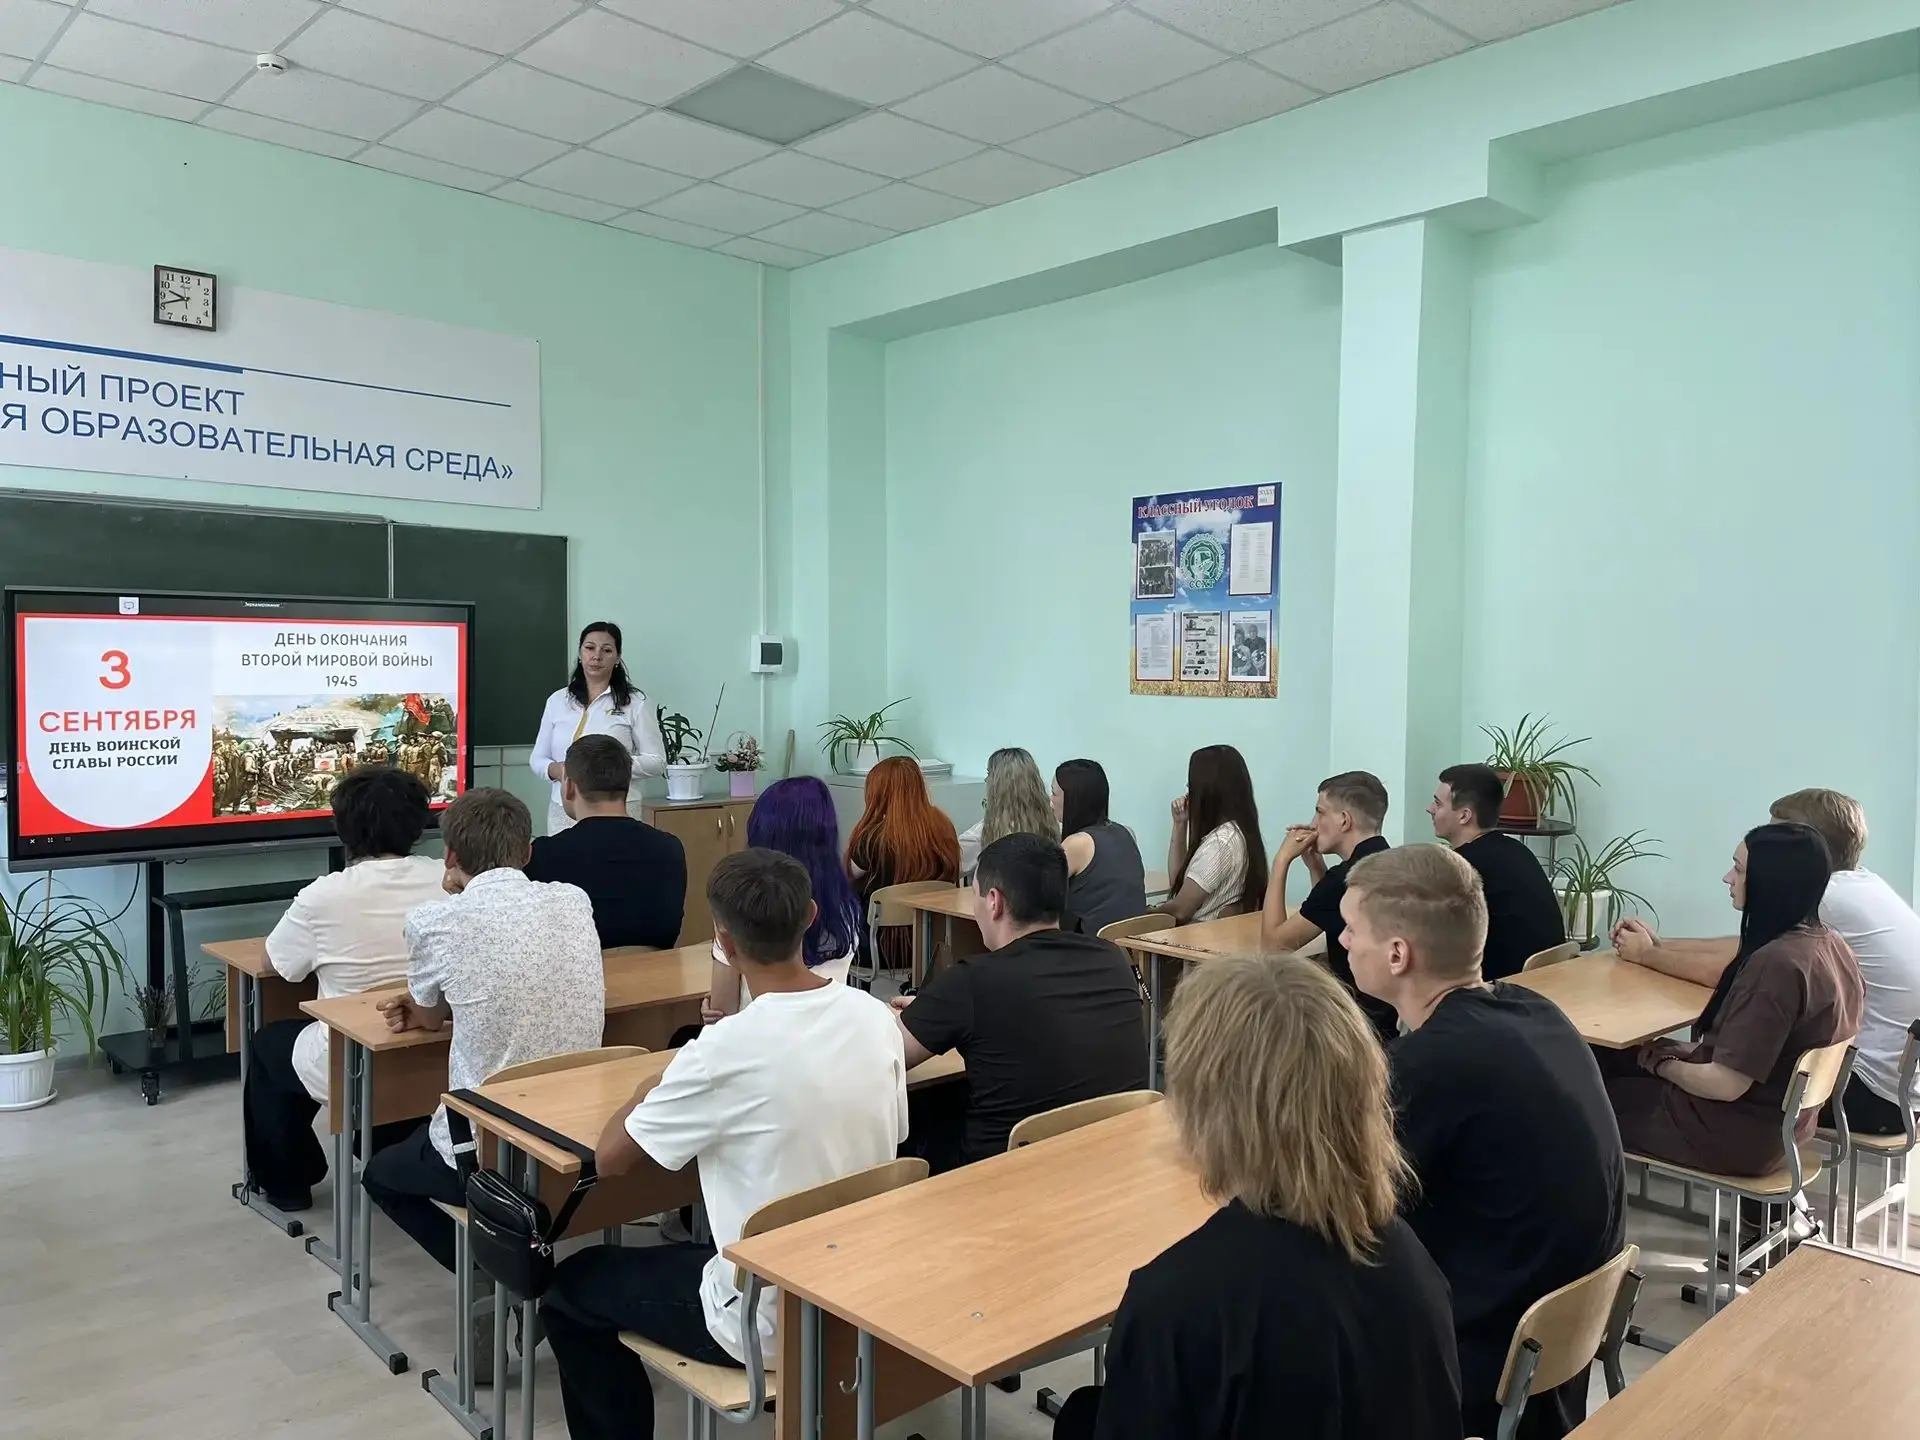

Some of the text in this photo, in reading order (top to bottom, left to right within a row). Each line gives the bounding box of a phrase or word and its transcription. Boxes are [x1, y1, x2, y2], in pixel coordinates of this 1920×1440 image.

[166, 273, 175, 281] 11
[180, 276, 191, 284] 12
[197, 278, 201, 286] 1
[161, 281, 170, 289] 10
[203, 288, 210, 296] 2
[160, 303, 166, 311] 8
[167, 312, 173, 320] 7
[181, 314, 188, 322] 6
[196, 317, 202, 325] 5
[101, 374, 245, 416] ПРОЕКТ
[41, 407, 395, 468] ОБРАЗОВАТЕЛЬНАЯ
[405, 447, 514, 482] СРЕДА»
[1138, 495, 1254, 519] КЛАССНЫЙ УГОЛОК
[275, 633, 408, 648] ДЕНЬ ОКОНЧАНИЯ
[241, 651, 433, 667] ВТОРОЙ МИРОВОЙ ВОЙНЫ
[99, 650, 131, 690] 3
[325, 674, 358, 688] 1945
[39, 710, 196, 732] СЕНТЯБРЯ
[49, 736, 181, 755] ДЕНЬ ВОИНСКОЙ
[52, 753, 178, 770] СЛАВЫ РОССИИ
